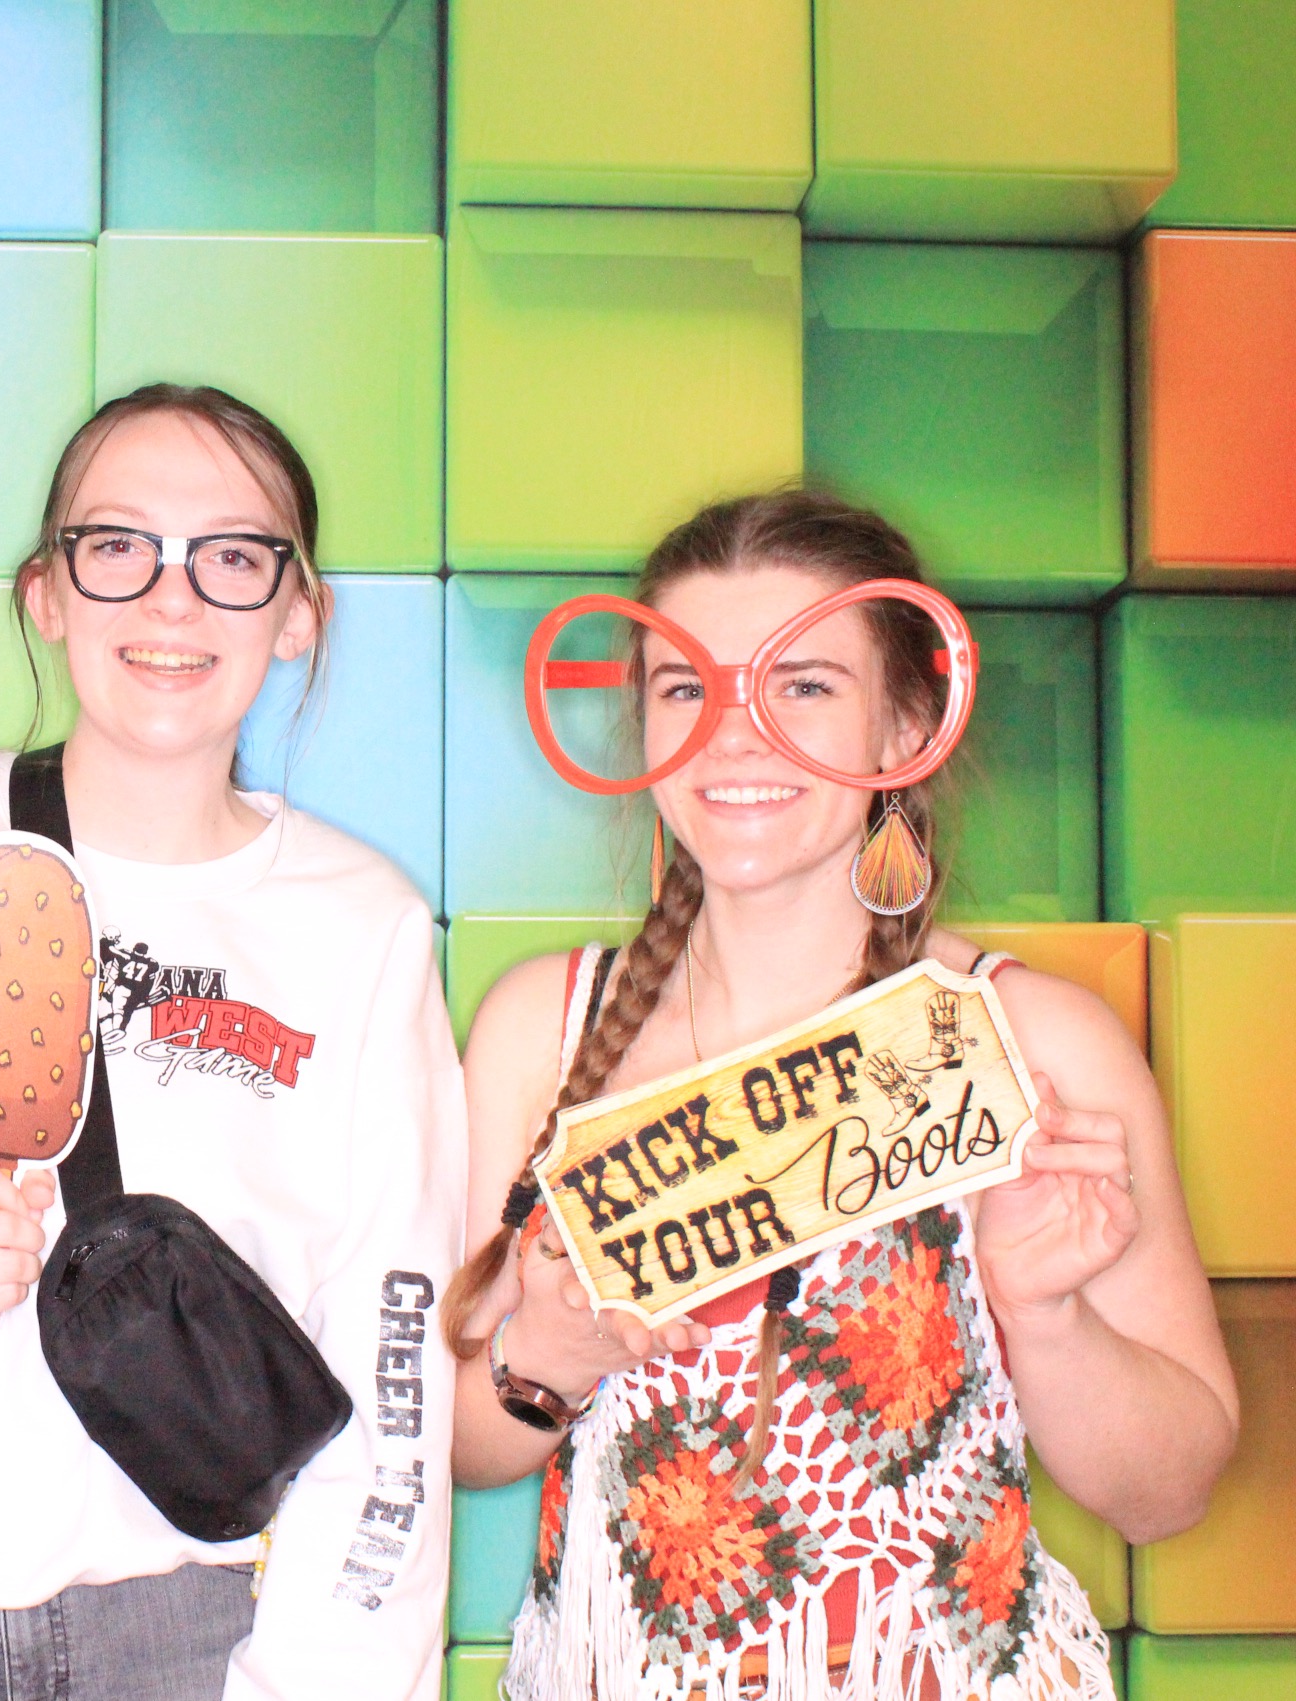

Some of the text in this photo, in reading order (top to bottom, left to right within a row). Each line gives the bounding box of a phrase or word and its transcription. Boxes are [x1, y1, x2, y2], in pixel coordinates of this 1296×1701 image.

[122, 960, 149, 982] 47
[134, 1028, 276, 1099] Game
[151, 994, 316, 1089] WEST
[562, 1030, 864, 1235] KICK OFF
[600, 1080, 1008, 1300] YOUR Boots
[375, 1269, 435, 1438] CHEER
